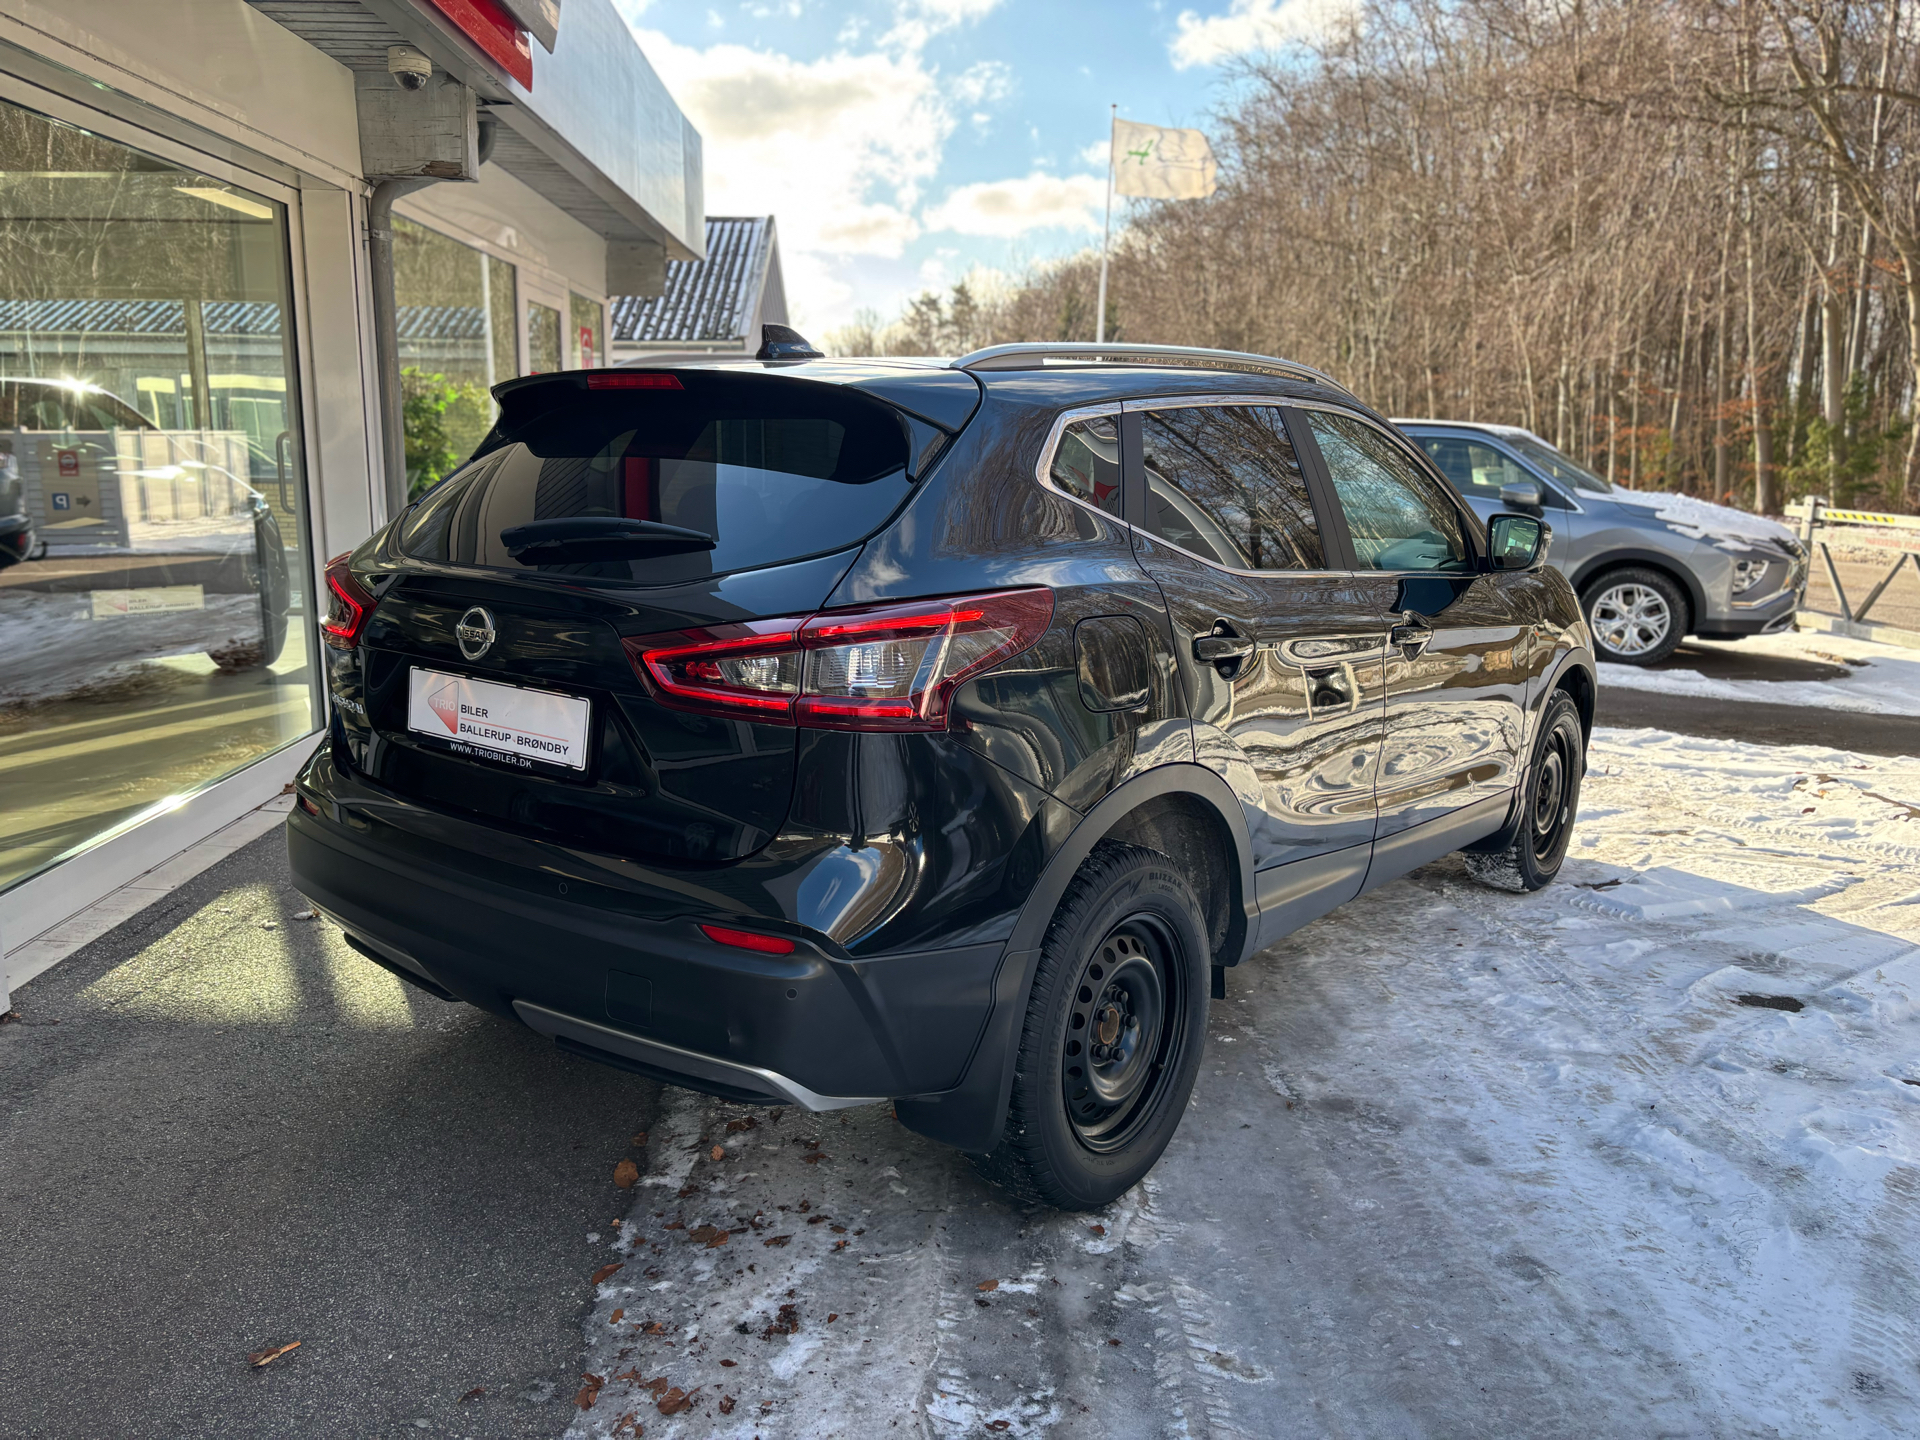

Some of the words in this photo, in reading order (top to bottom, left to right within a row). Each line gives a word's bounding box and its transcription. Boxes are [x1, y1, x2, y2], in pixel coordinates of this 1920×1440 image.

[434, 697, 456, 712] TRIO
[460, 704, 489, 719] BILER
[460, 723, 512, 743] BALLERUP
[450, 742, 533, 769] WWW.TRIOBILER.DK
[1148, 872, 1183, 891] BLIZZAK
